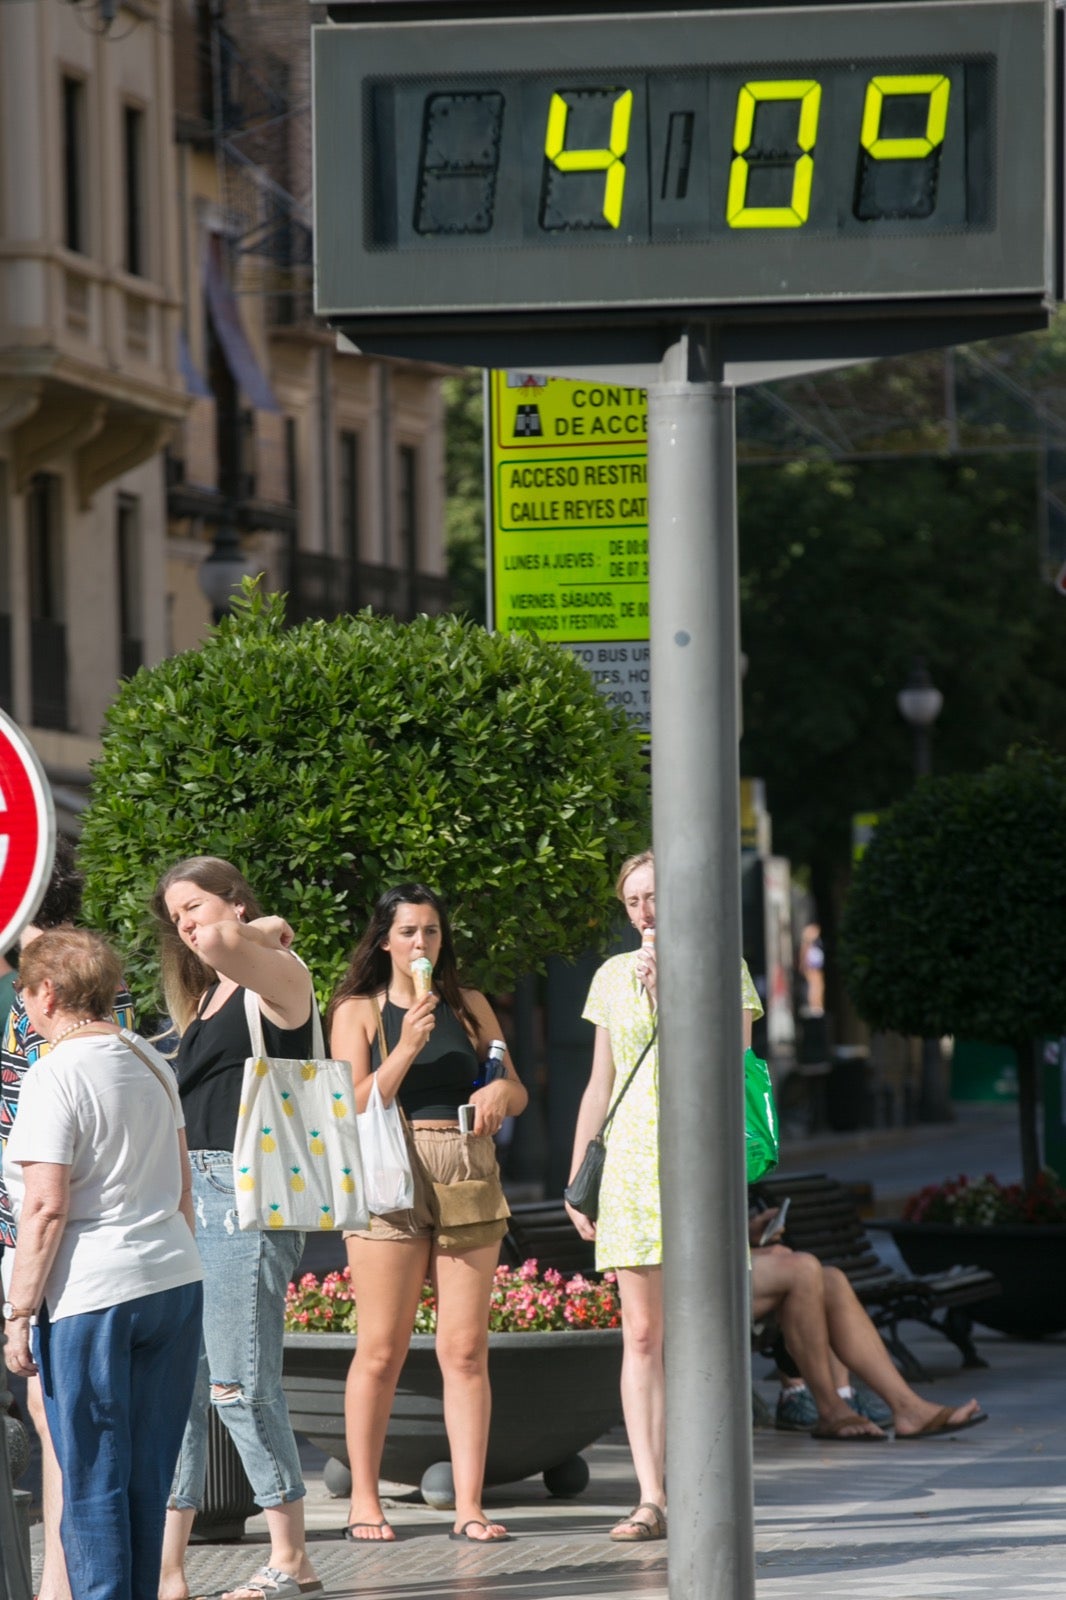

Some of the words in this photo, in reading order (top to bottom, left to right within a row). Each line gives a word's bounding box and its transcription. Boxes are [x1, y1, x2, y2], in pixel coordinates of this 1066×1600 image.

[572, 388, 648, 408] CONTR
[555, 417, 585, 436] DE
[510, 466, 579, 489] ACCESO
[584, 464, 647, 486] RESTRI
[510, 501, 559, 522] CALLE
[564, 499, 615, 519] REYES
[609, 540, 624, 556] DE
[504, 554, 540, 571] LUNES
[542, 554, 551, 569] A
[610, 561, 625, 577] DE
[620, 602, 635, 618] DE
[598, 648, 628, 662] BUS
